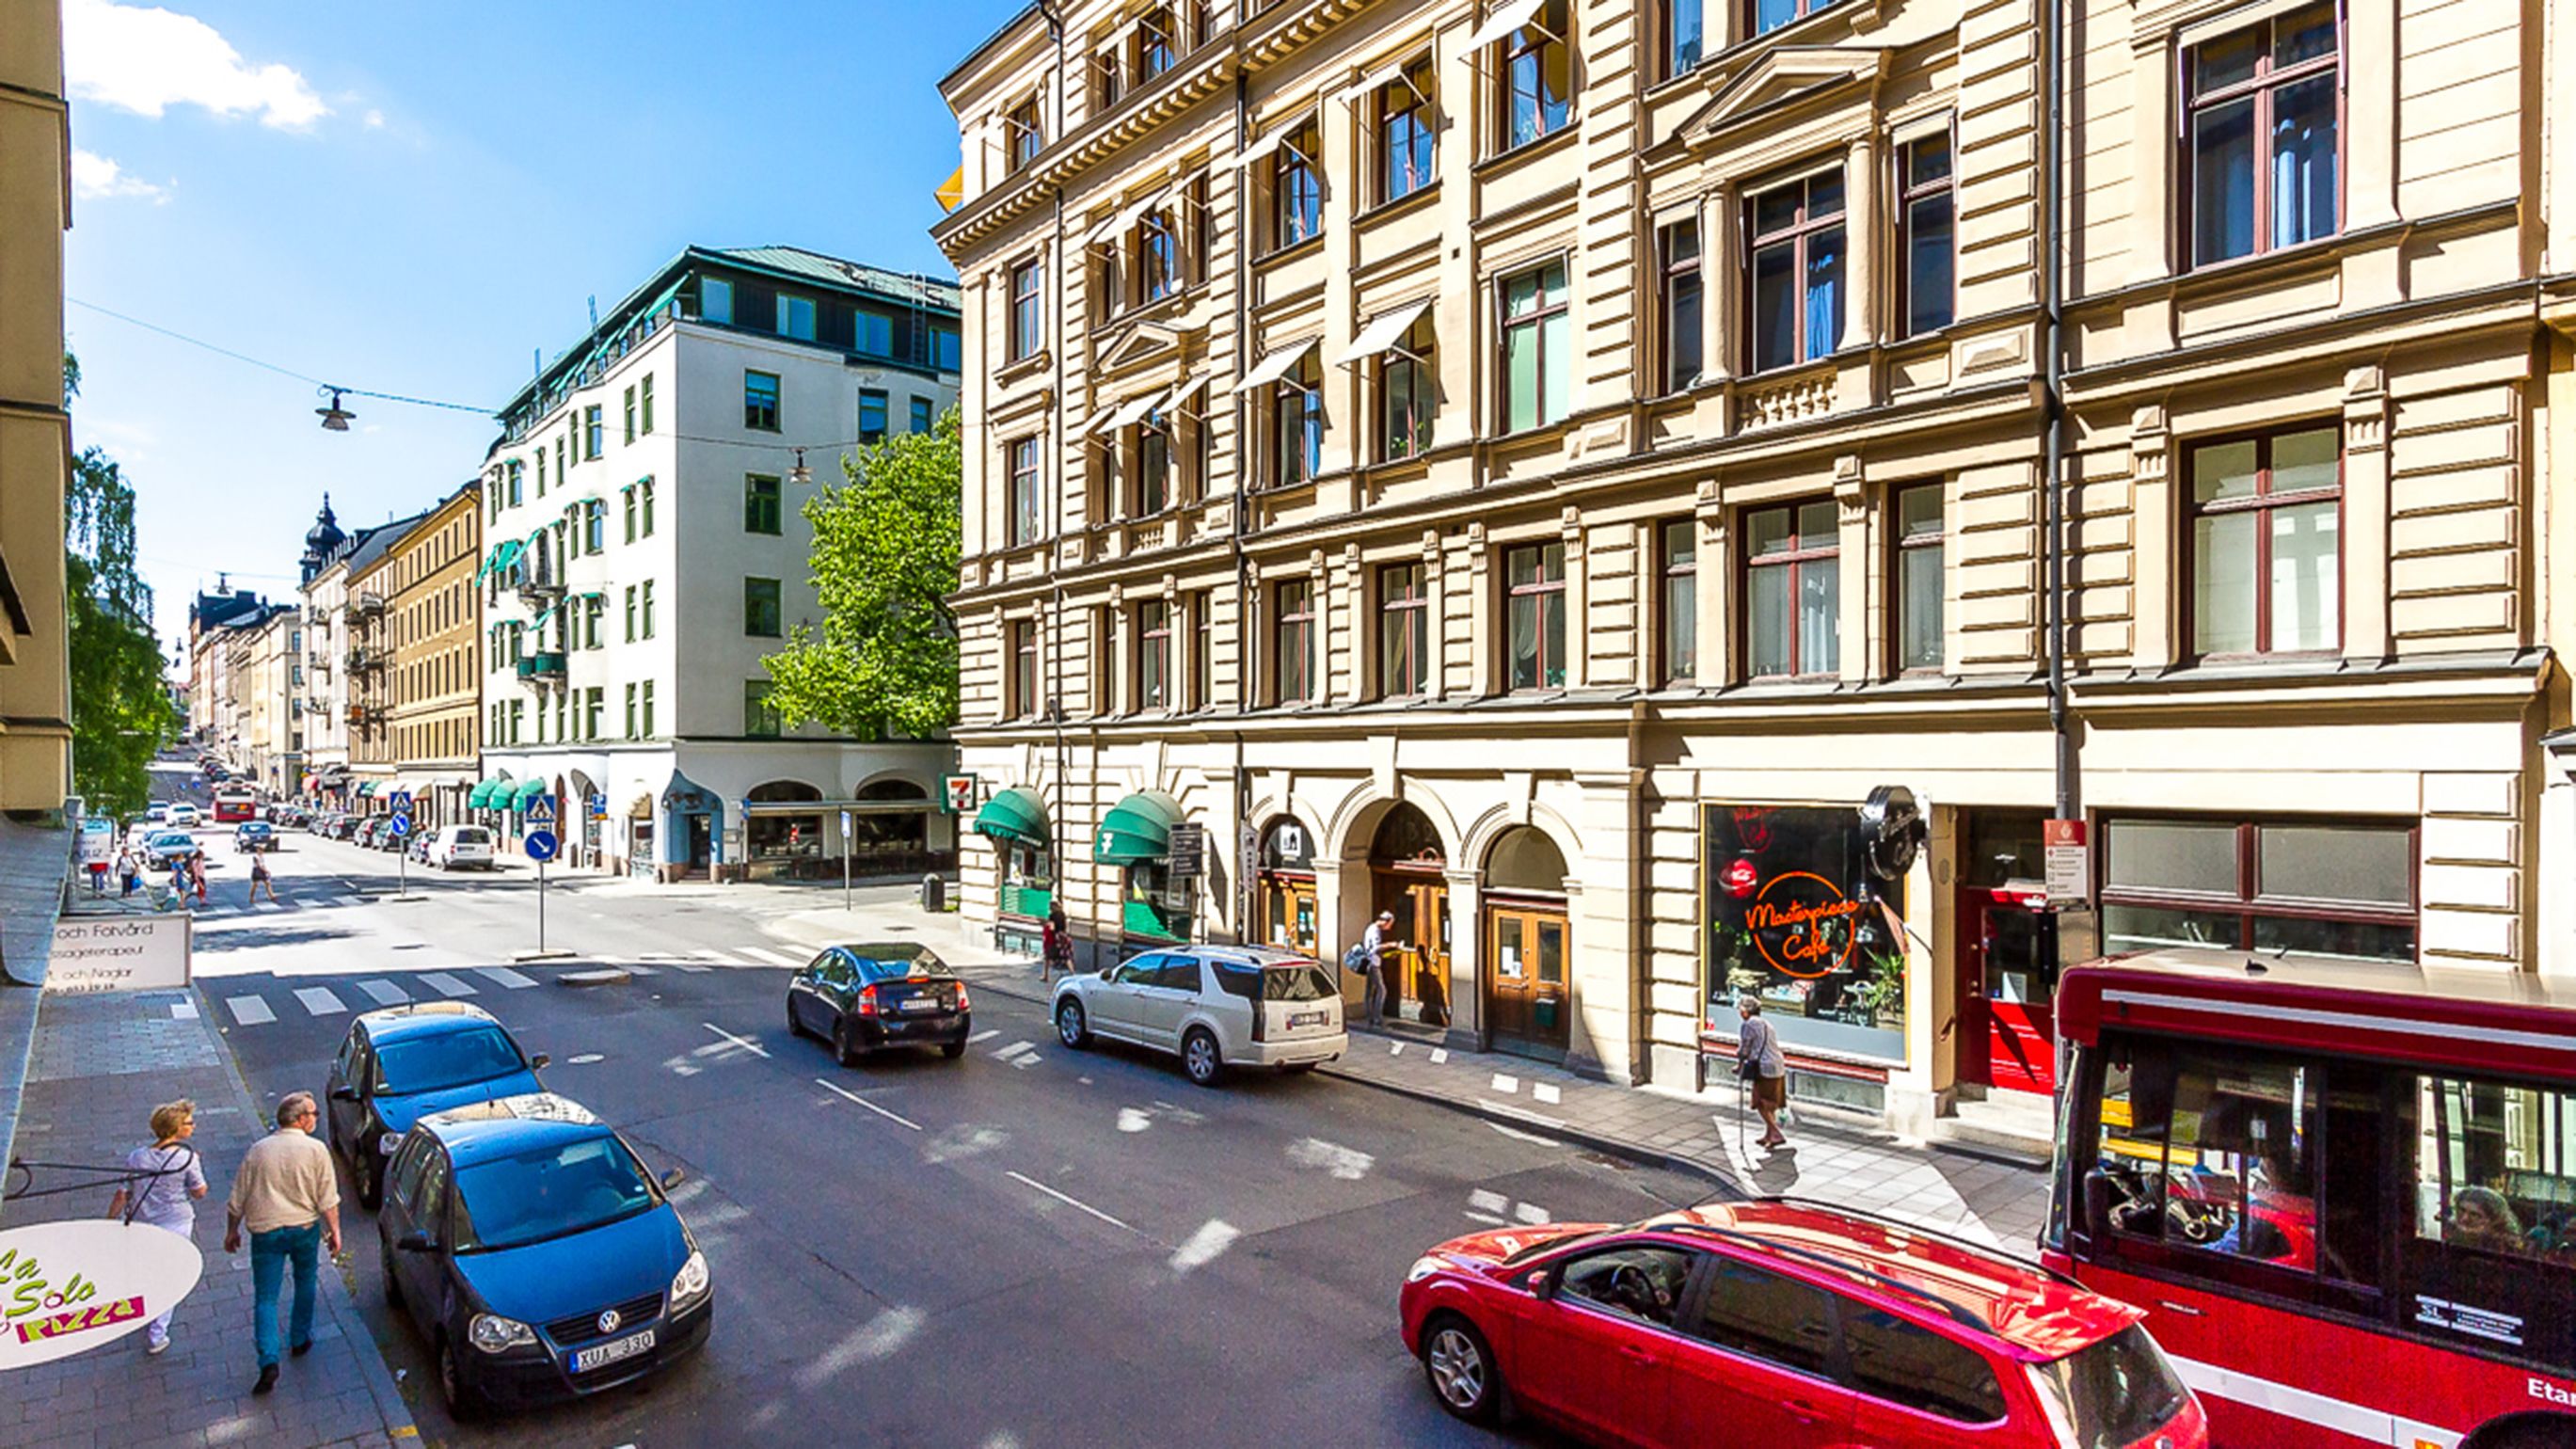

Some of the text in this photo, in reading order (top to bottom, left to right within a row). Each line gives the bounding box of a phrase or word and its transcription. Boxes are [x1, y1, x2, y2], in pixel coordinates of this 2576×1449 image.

[56, 923, 153, 939] och Fotvård
[1745, 900, 1859, 934] Masterpiece
[580, 1331, 652, 1366] XUA 330
